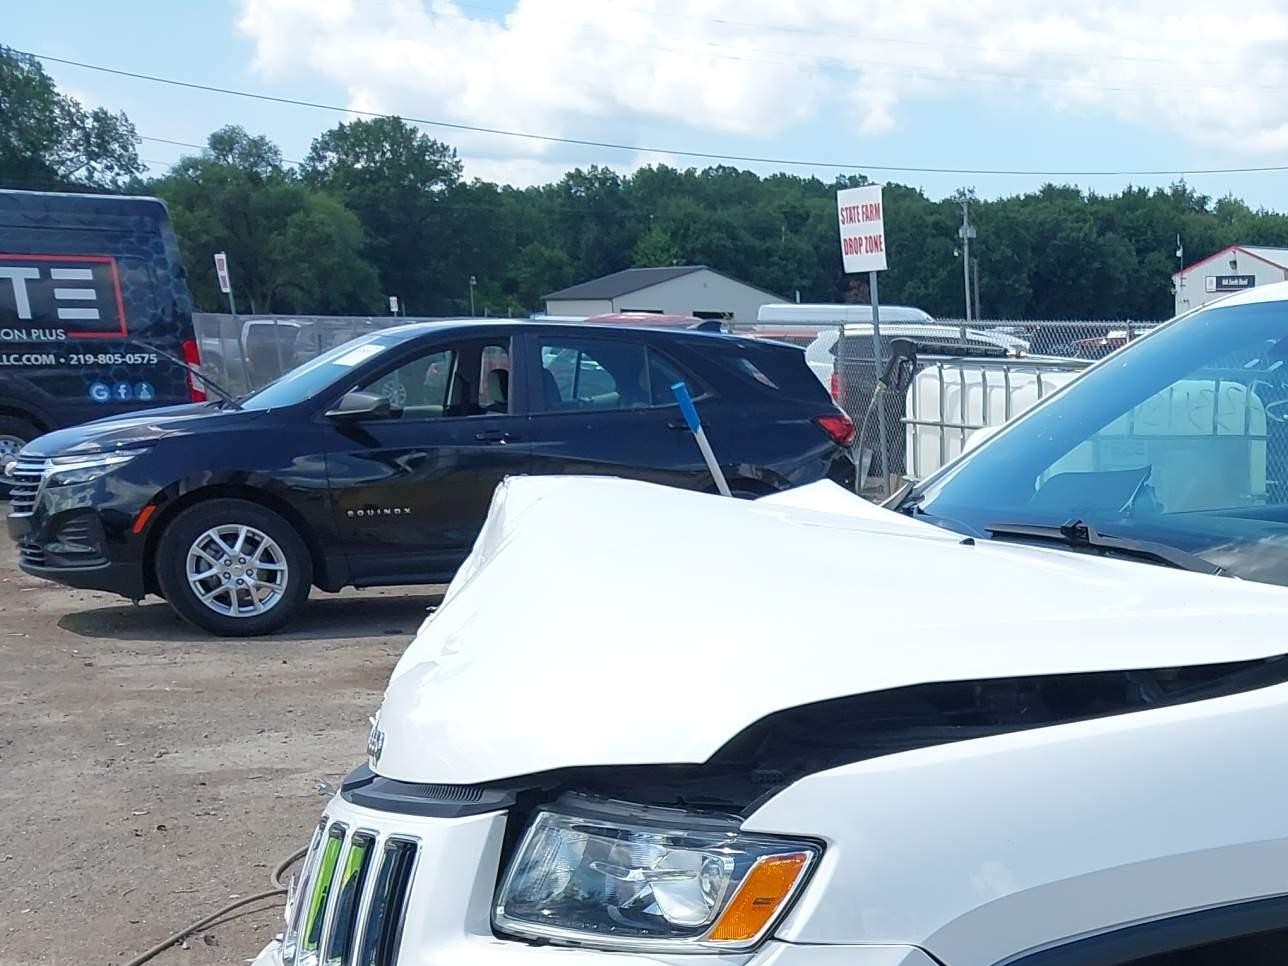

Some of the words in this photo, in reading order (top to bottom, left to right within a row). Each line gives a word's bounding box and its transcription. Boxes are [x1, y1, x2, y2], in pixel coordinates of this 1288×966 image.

[840, 205, 861, 225] STATE
[861, 202, 881, 223] FARM
[843, 236, 863, 256] DROP
[864, 234, 884, 254] ZONE
[31, 328, 67, 340] PLUS
[69, 353, 158, 365] 219-805-0575
[346, 507, 412, 517] EQUINOX
